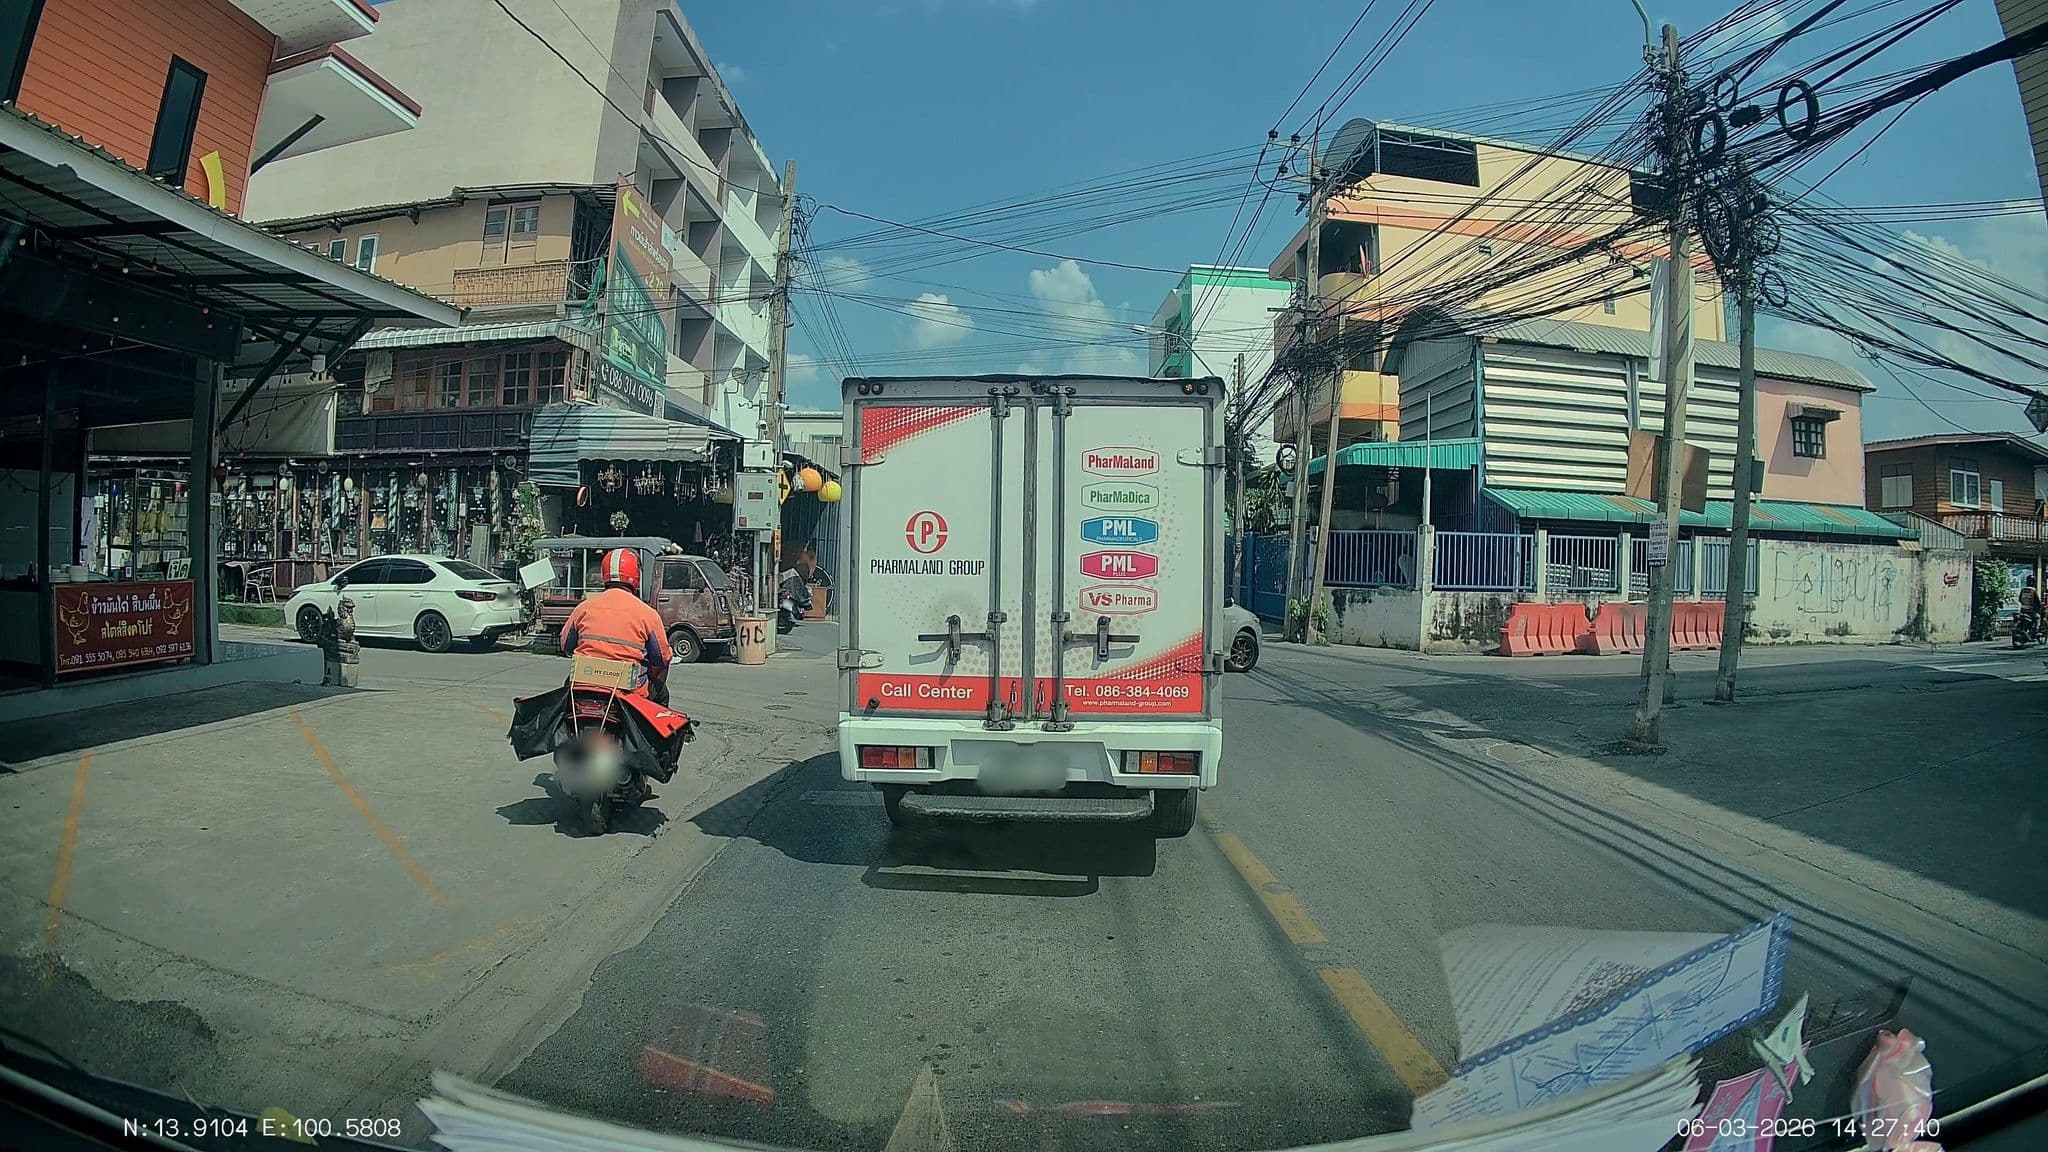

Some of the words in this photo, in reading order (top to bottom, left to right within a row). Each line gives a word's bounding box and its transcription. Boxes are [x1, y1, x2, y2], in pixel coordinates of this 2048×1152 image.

[609, 367, 623, 390] 086
[624, 375, 637, 399] 314
[1088, 455, 1154, 469] PharMaLand
[1090, 490, 1150, 503] PharMaDica
[1102, 520, 1137, 536] PML
[870, 559, 943, 575] PHARMALAND
[949, 559, 985, 576] GROUP
[1101, 555, 1137, 572] PML
[91, 595, 129, 615] ข้าวมันไก่
[132, 587, 161, 612] สิบหมื่น
[1088, 592, 1112, 606] VS
[1115, 593, 1151, 606] Pharma
[881, 682, 911, 697] Call
[918, 683, 973, 699] Center
[1065, 684, 1090, 697] Tel.
[1095, 685, 1189, 698] 086-384-4069
